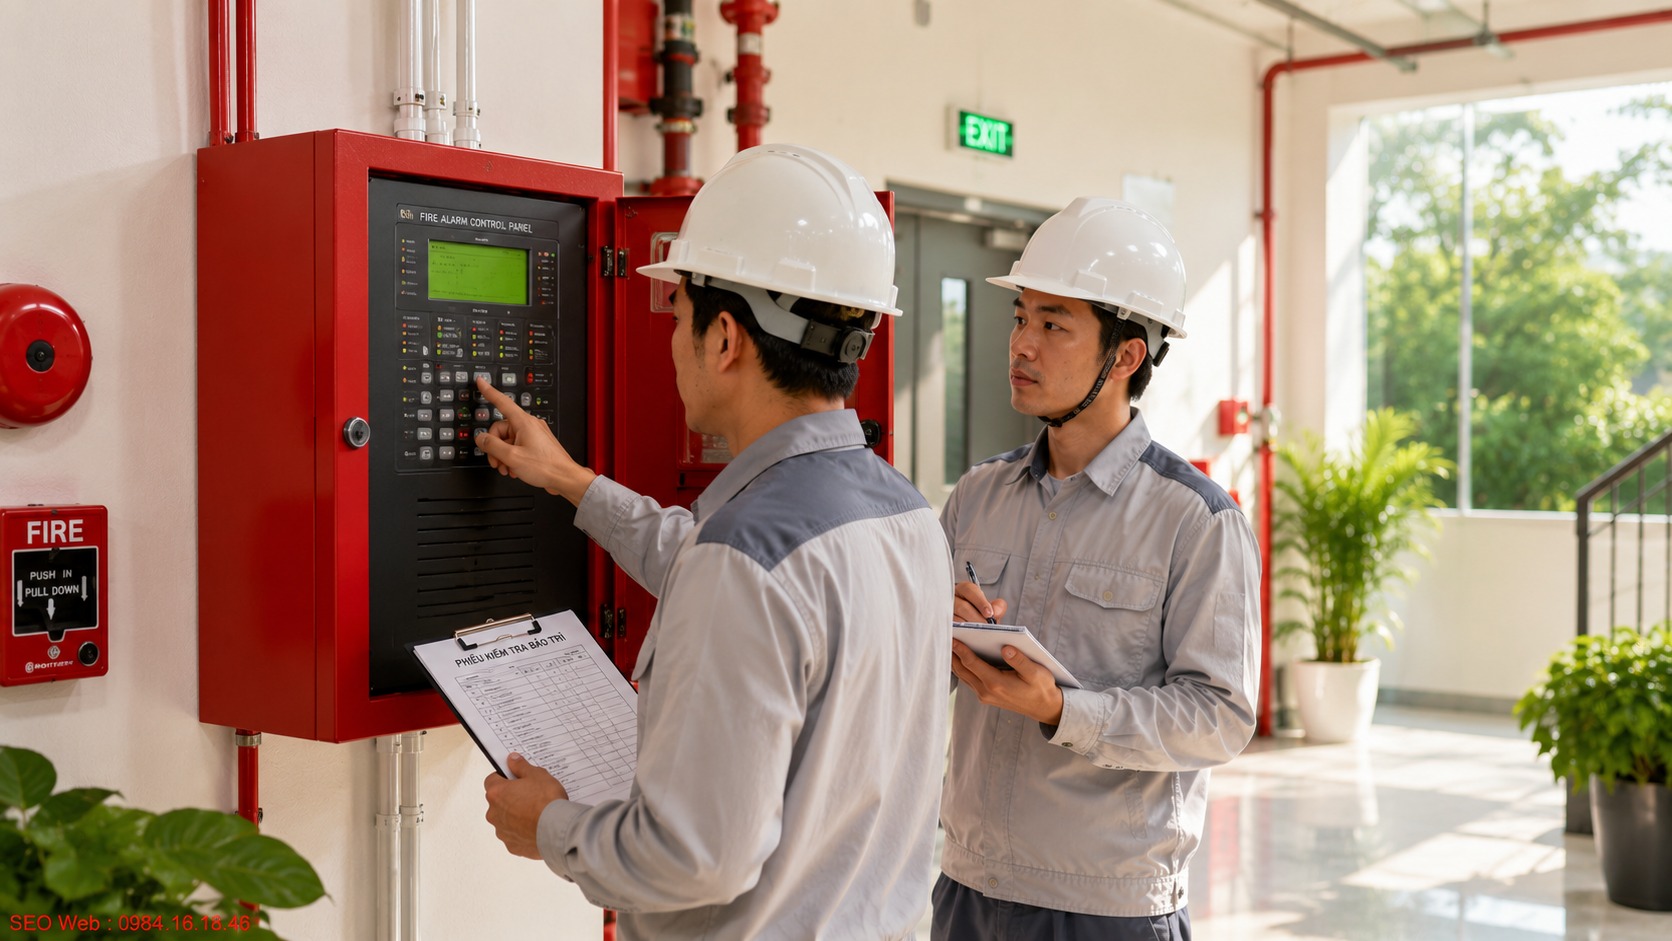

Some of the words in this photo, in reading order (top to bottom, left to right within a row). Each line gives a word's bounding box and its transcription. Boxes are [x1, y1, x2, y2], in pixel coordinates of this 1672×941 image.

[965, 115, 1009, 154] EXIT
[420, 212, 438, 223] FIRE
[441, 214, 468, 226] ALARM
[470, 217, 507, 230] CONTROL
[508, 221, 533, 234] PANEL
[27, 519, 84, 545] FIRE
[30, 570, 56, 580] PUSH
[63, 569, 73, 578] IN
[25, 587, 49, 598] PULL
[52, 585, 79, 596] DOWN
[508, 644, 529, 655] TRA
